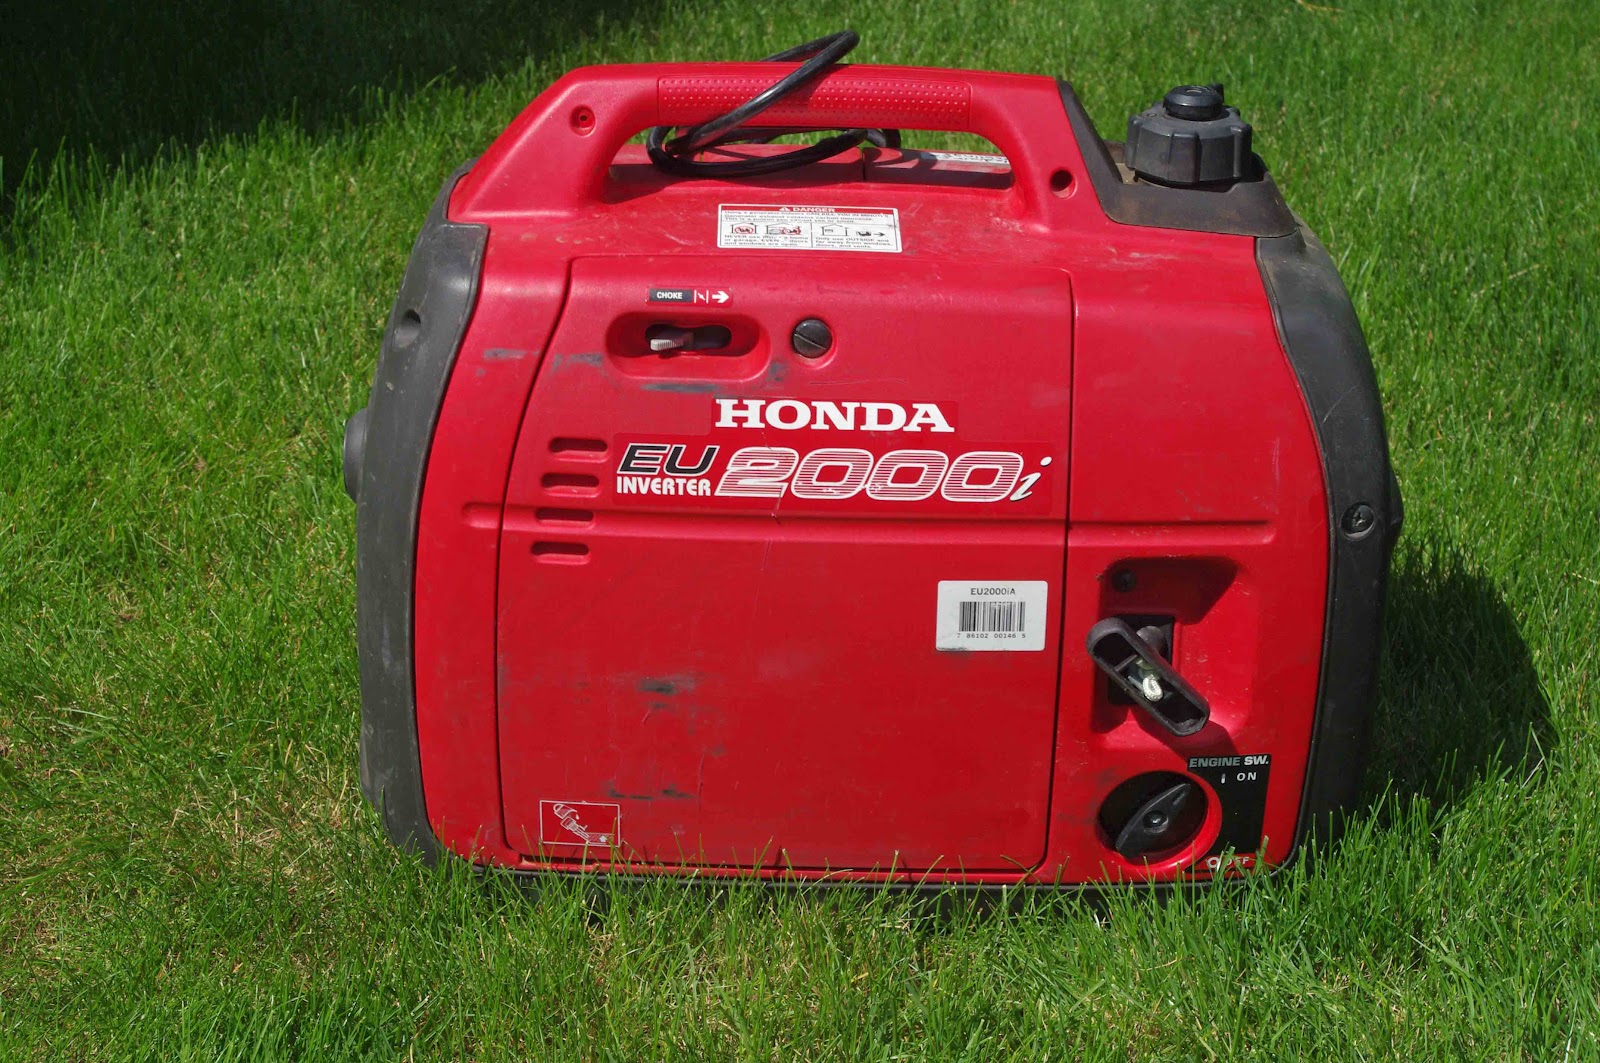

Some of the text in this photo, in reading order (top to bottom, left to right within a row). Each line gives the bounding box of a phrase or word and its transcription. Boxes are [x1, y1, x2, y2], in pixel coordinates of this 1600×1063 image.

[656, 291, 683, 300] CHOKE
[714, 398, 955, 433] HONDA
[616, 442, 720, 477] EU
[616, 476, 711, 496] INVERTER
[970, 587, 1016, 596] EU2000iA
[1188, 754, 1270, 768] ENGINE SW.
[1236, 771, 1257, 782] ON
